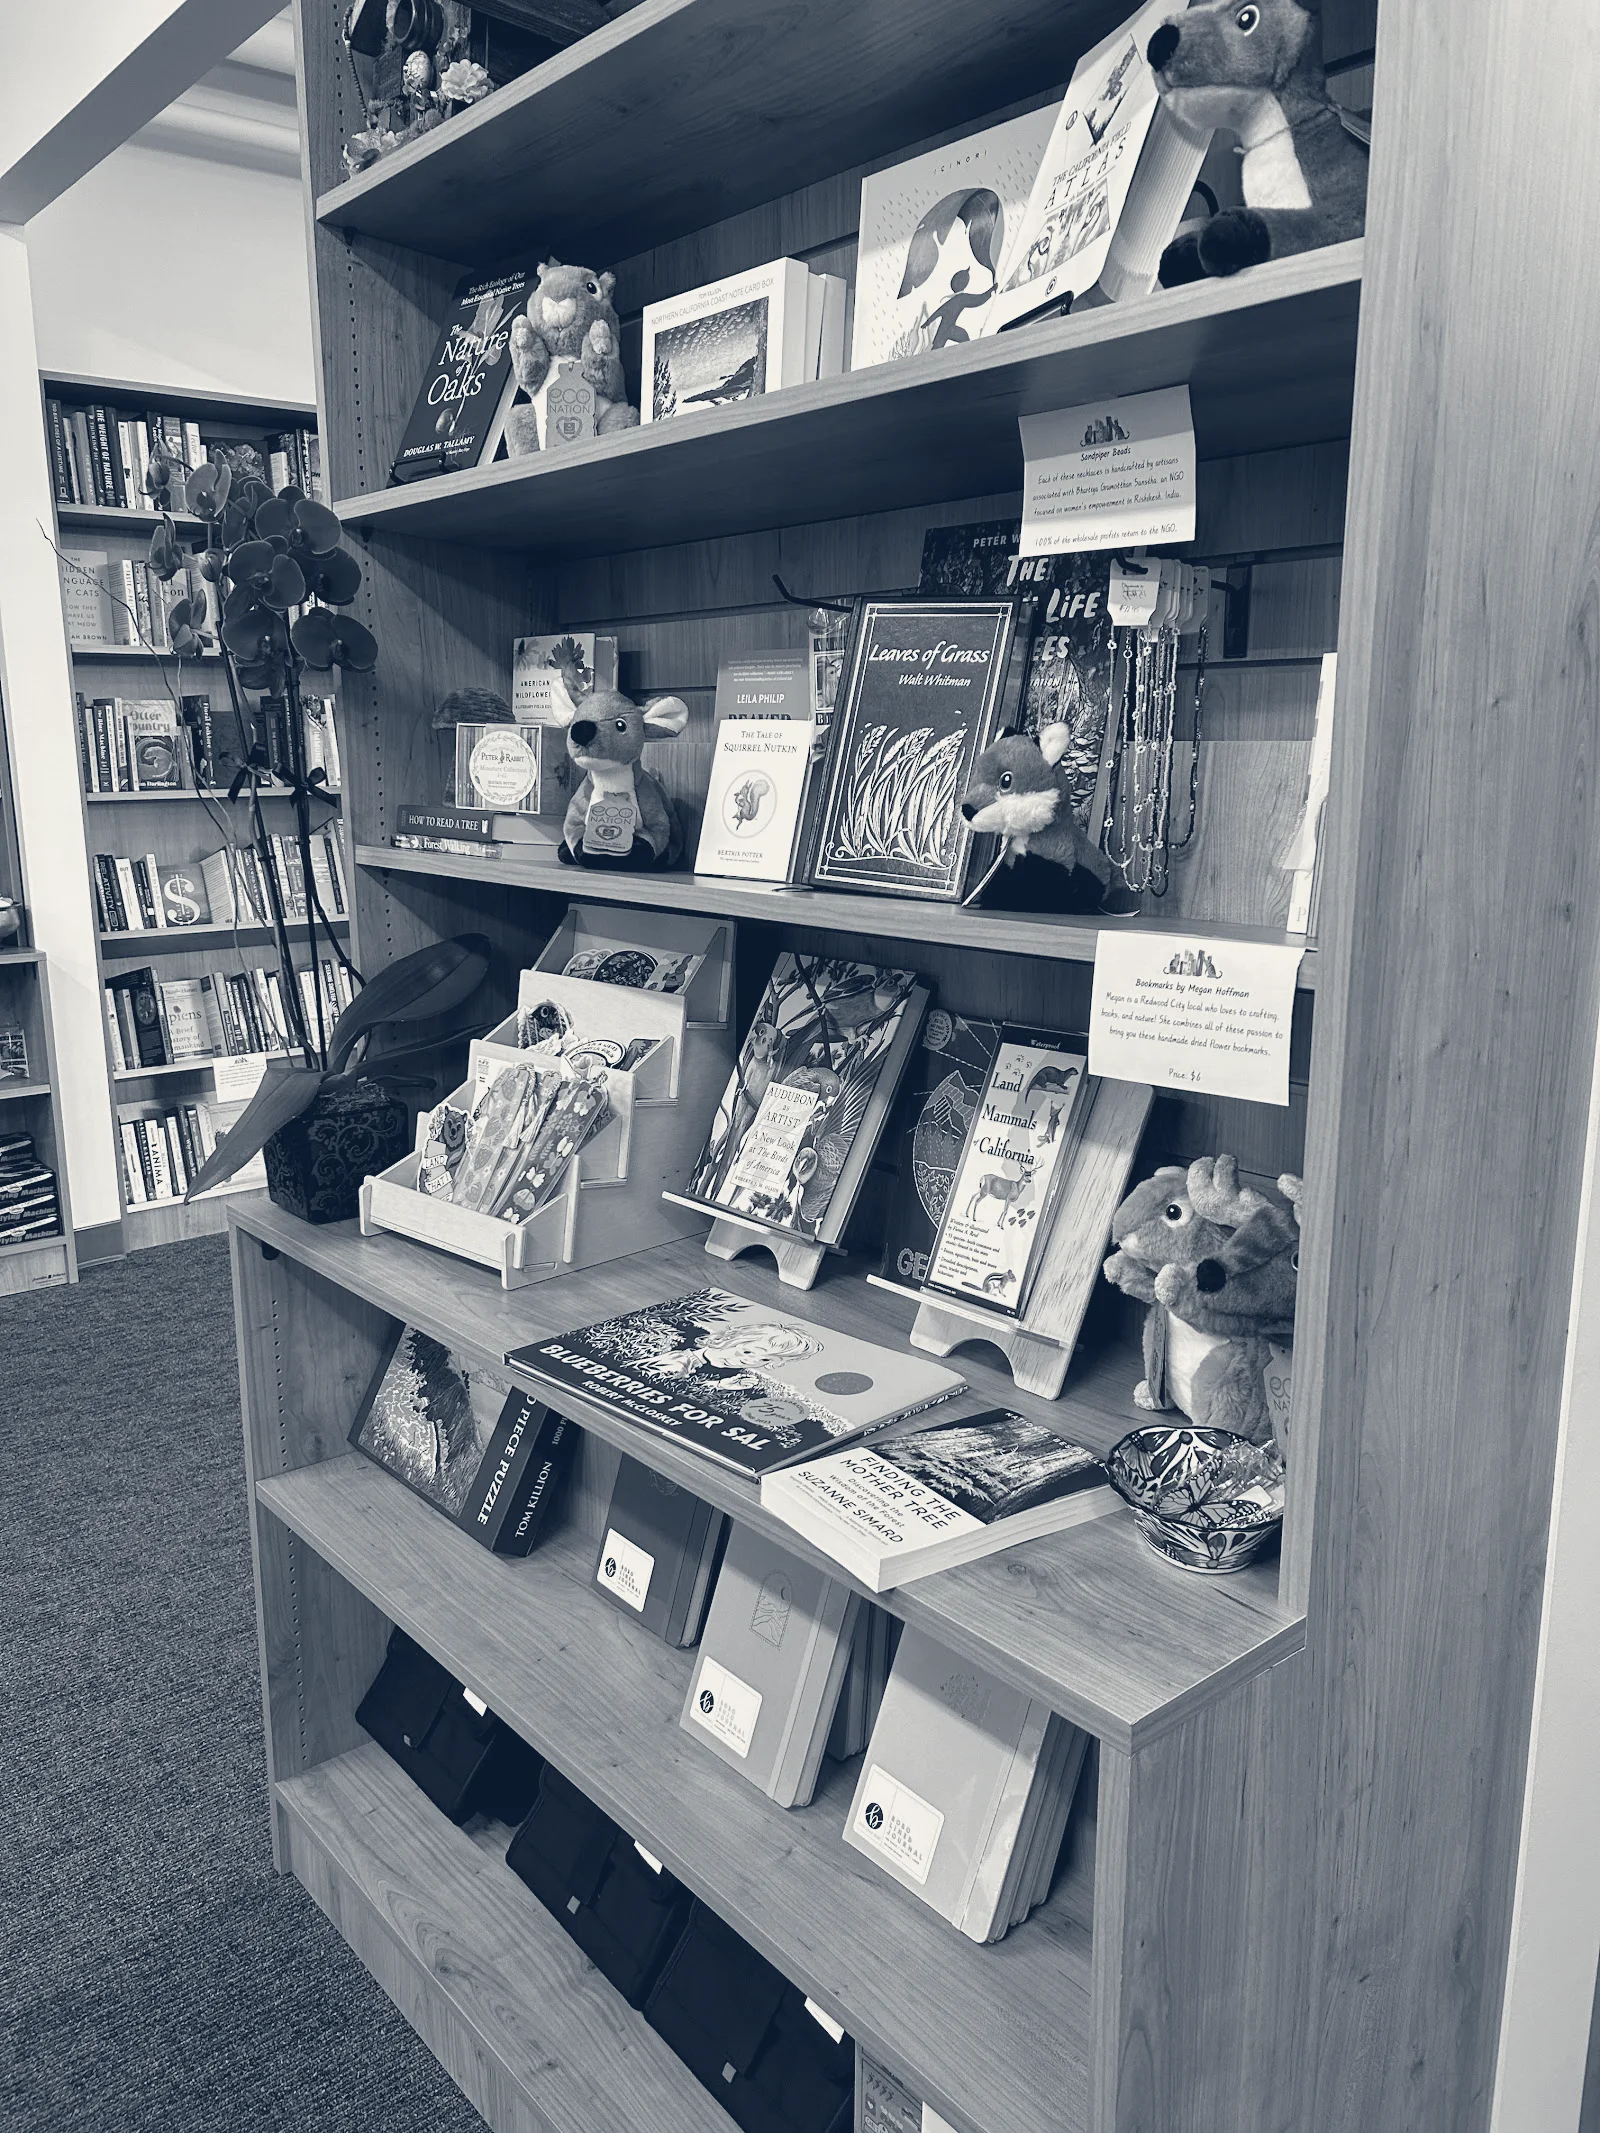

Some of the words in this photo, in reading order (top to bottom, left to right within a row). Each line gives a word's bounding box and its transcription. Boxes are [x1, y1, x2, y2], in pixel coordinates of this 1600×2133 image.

[1044, 137, 1126, 210] ATLAS
[651, 311, 678, 326] NORTHERN
[679, 300, 710, 316] CALIFORNIA
[711, 292, 728, 306] COAST
[729, 288, 744, 298] NOTE
[744, 281, 760, 294] CARD
[762, 277, 774, 289] BOX
[450, 324, 463, 336] The
[438, 330, 510, 366] Nature
[427, 362, 486, 406] Oaks
[549, 404, 590, 414] NATION
[97, 423, 108, 450] WEIGHT
[103, 462, 114, 489] NATURE
[403, 444, 434, 457] DOUGLAS
[444, 436, 475, 448] TALLAMY
[1081, 451, 1109, 461] Sandpiper
[1113, 446, 1131, 456] Beads
[1077, 468, 1103, 478] necklaces
[1112, 461, 1144, 473] handcrafted
[1155, 458, 1179, 466] artisans
[1032, 489, 1061, 501] associated
[1170, 471, 1184, 481] NGO
[1034, 505, 1055, 516] focused
[973, 535, 1004, 549] PETER
[1072, 532, 1098, 543] wholesale
[1100, 530, 1119, 542] profits
[1007, 555, 1048, 587] THE
[64, 578, 104, 586] NGUAGE
[868, 644, 919, 664] Leaves
[922, 640, 942, 671] of
[940, 644, 991, 664] Grass
[1032, 635, 1070, 662] EES
[899, 674, 923, 687] Walt
[924, 675, 972, 688] Whitman
[737, 694, 757, 704] LEILA
[759, 694, 785, 704] PHILIP
[130, 710, 161, 720] Otter
[741, 730, 755, 739] THE
[756, 731, 772, 739] TALE
[724, 742, 762, 753] SQUIRREL
[764, 742, 798, 754] NUTKIN
[409, 815, 426, 825] HOW
[437, 818, 454, 828] READ
[462, 820, 478, 830] TREE
[717, 849, 740, 858] BEATRIX
[100, 862, 115, 909] RELATIVITY
[1136, 978, 1173, 991] Bookmarks
[1176, 983, 1185, 994] by
[1188, 983, 1212, 995] Megan
[1215, 986, 1250, 998] Hoffman
[1106, 992, 1125, 1003] Megan
[1140, 995, 1168, 1008] Redwood
[1170, 999, 1185, 1012] City
[1187, 1001, 1203, 1012] local
[1205, 1003, 1218, 1013] who
[1220, 1004, 1237, 1015] loves
[169, 1009, 202, 1025] piens
[1122, 1012, 1133, 1021] and
[1134, 1015, 1157, 1024] nature!
[1159, 1015, 1171, 1025] She
[1173, 1018, 1203, 1030] combines
[1225, 1023, 1244, 1035] these
[1246, 1027, 1273, 1038] passion
[1030, 1038, 1061, 1050] Waterproof
[1109, 1026, 1124, 1039] bring
[1126, 1030, 1137, 1039] you
[1139, 1030, 1156, 1041] these
[1157, 1033, 1188, 1045] handmade
[1190, 1036, 1207, 1048] dried
[1209, 1038, 1231, 1051] flower
[1232, 1041, 1271, 1056] bookmarks.
[991, 1072, 1024, 1093] Land
[1169, 1067, 1188, 1080] Price:
[1190, 1071, 1201, 1082] $6
[767, 1087, 815, 1107] AUDUBON
[764, 1112, 800, 1128] ARTIST
[981, 1103, 1038, 1130] Mammals
[760, 1132, 776, 1144] New
[777, 1137, 795, 1151] Look
[979, 1136, 1036, 1166] California
[425, 1156, 445, 1169] LAND
[757, 1146, 769, 1157] The
[770, 1150, 789, 1163] Birds
[753, 1162, 780, 1176] America
[21, 1186, 54, 1196] Machine
[23, 1207, 56, 1218] Machine
[0, 1235, 22, 1244] lying
[25, 1229, 58, 1240] Machine
[539, 1344, 673, 1407] BLUEBERRIES
[668, 1402, 725, 1430] FOR
[721, 1424, 772, 1452] SAL
[581, 1379, 623, 1402] ROBERT
[620, 1398, 683, 1429] McCLOSKEY
[749, 1402, 784, 1413] 75
[504, 1408, 532, 1466] PIECE
[476, 1458, 511, 1526] PUZZLE
[840, 1460, 904, 1499] MOTHER
[904, 1499, 949, 1532] TREE
[848, 1478, 890, 1508] Discovering
[890, 1504, 903, 1517] the
[860, 1456, 926, 1497] FINDING
[928, 1496, 962, 1521] THE
[515, 1510, 534, 1538] TOM
[526, 1460, 553, 1508] KILLION
[798, 1471, 857, 1510] SUZANNE
[853, 1509, 903, 1543] SIMARD
[829, 1474, 857, 1495] Wisdom
[866, 1500, 880, 1510] the
[880, 1510, 906, 1528] Forest
[716, 1713, 745, 1738] JOURNAL
[887, 1830, 923, 1861] JOURNAL
